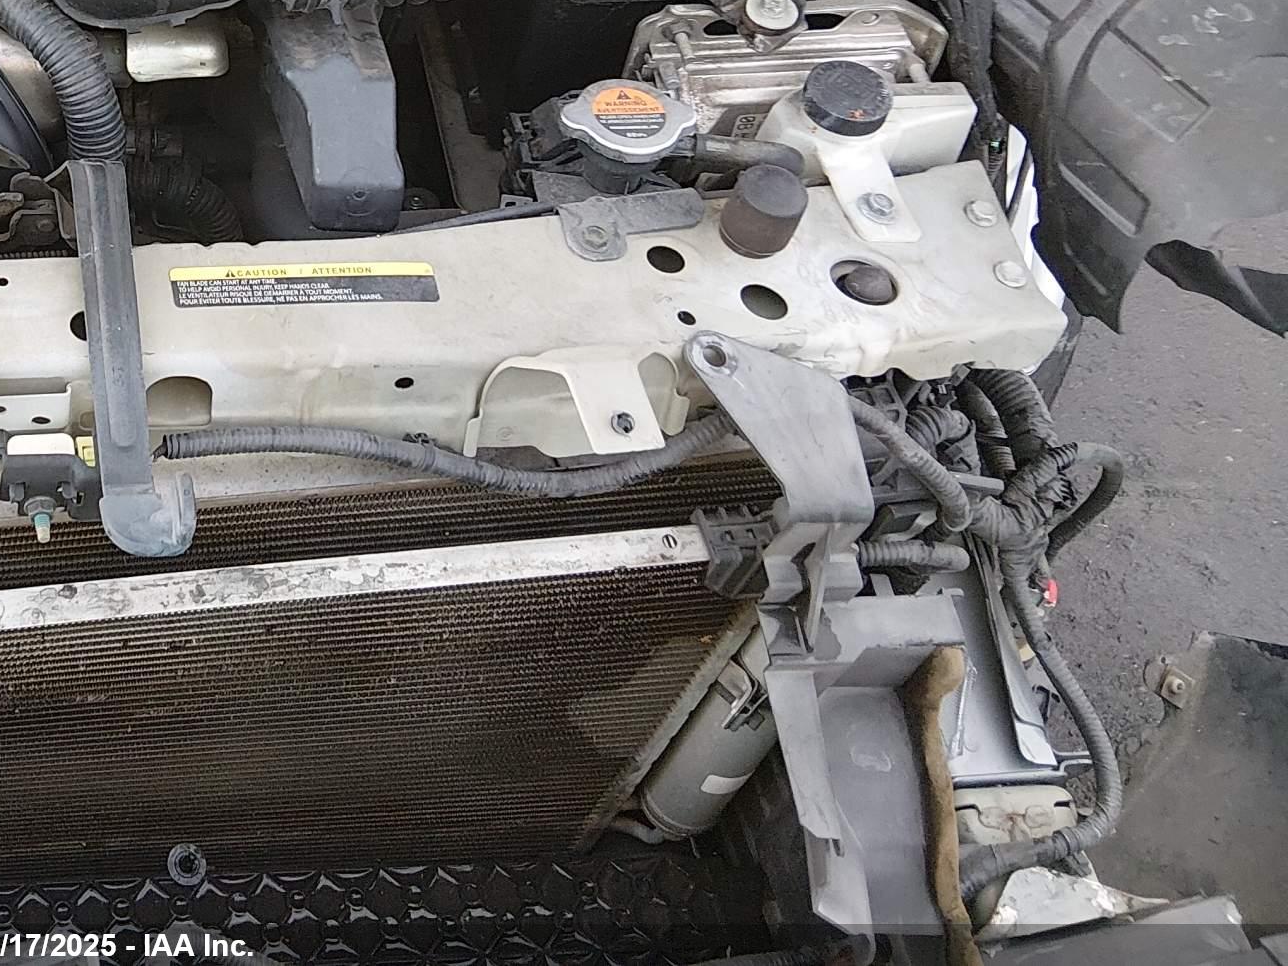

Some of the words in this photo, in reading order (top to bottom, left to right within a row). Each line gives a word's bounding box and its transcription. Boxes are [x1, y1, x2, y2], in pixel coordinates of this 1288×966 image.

[236, 268, 287, 276] CAUTION
[312, 266, 372, 275] ATTENTION
[180, 297, 198, 305] POUR
